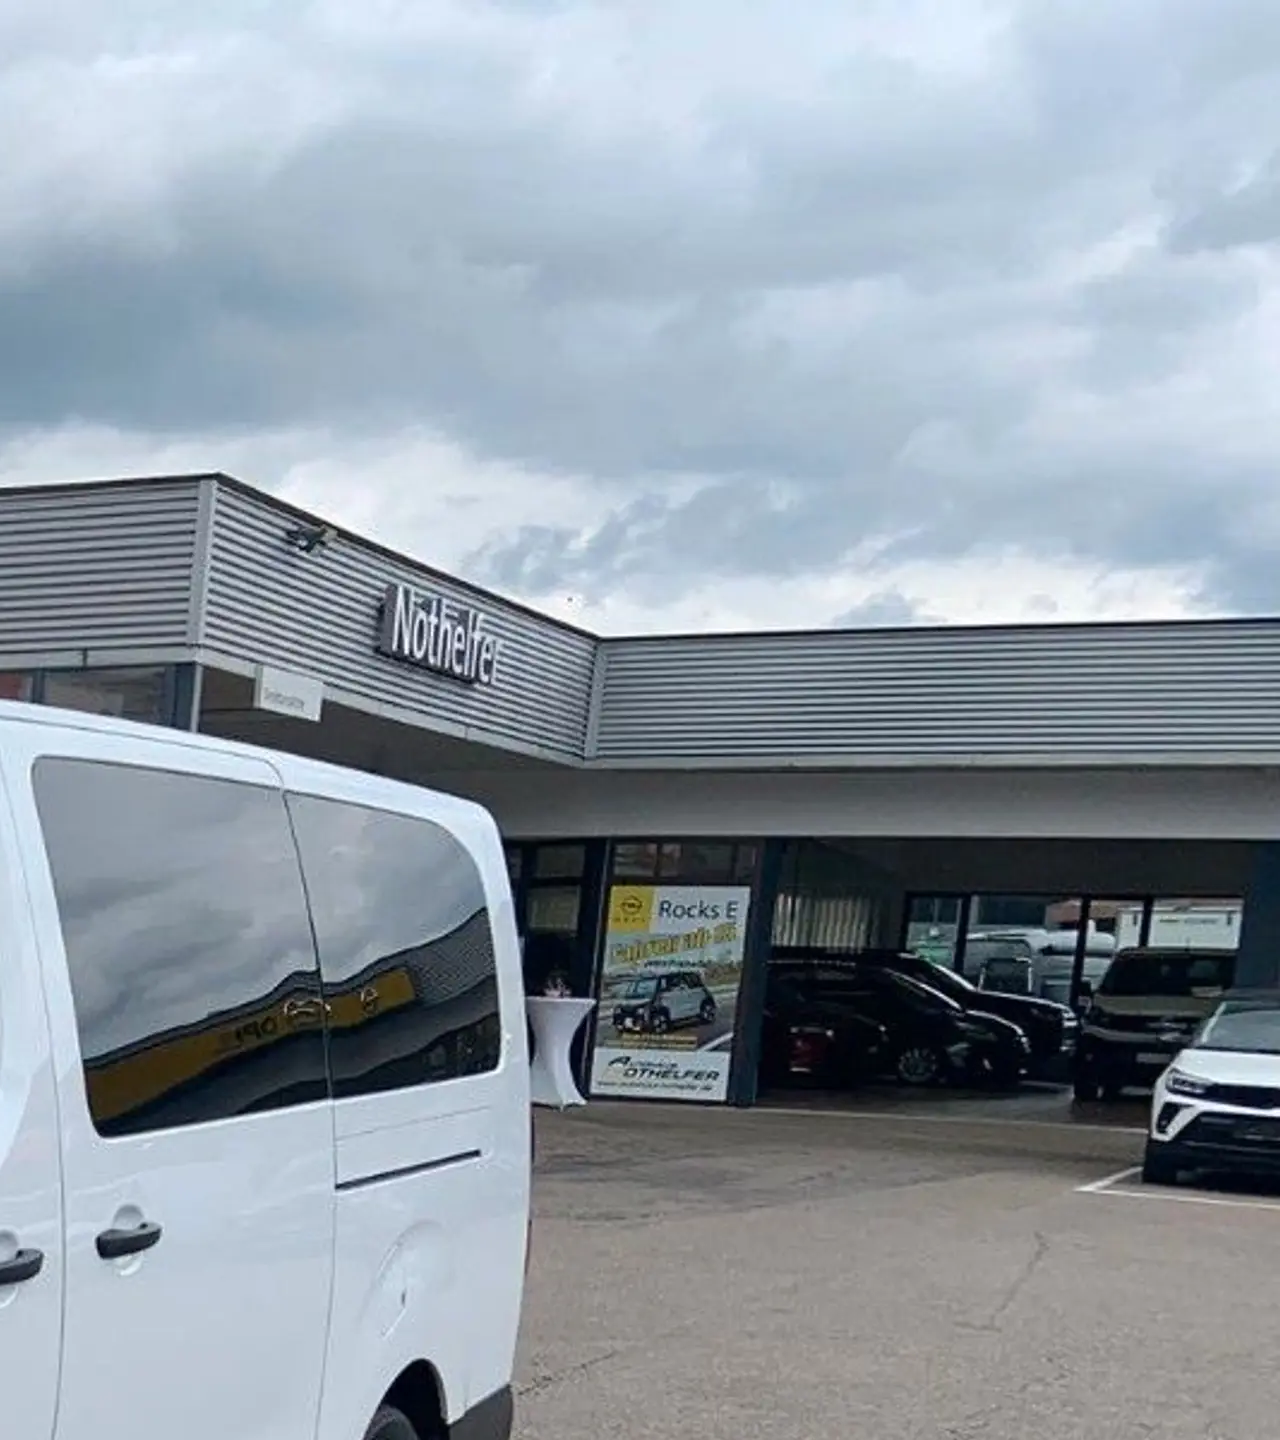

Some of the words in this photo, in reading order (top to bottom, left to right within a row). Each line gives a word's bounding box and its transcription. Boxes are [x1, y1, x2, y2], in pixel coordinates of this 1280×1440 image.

[391, 584, 500, 684] Nothelfer
[659, 899, 721, 920] Rocks
[726, 900, 739, 918] E
